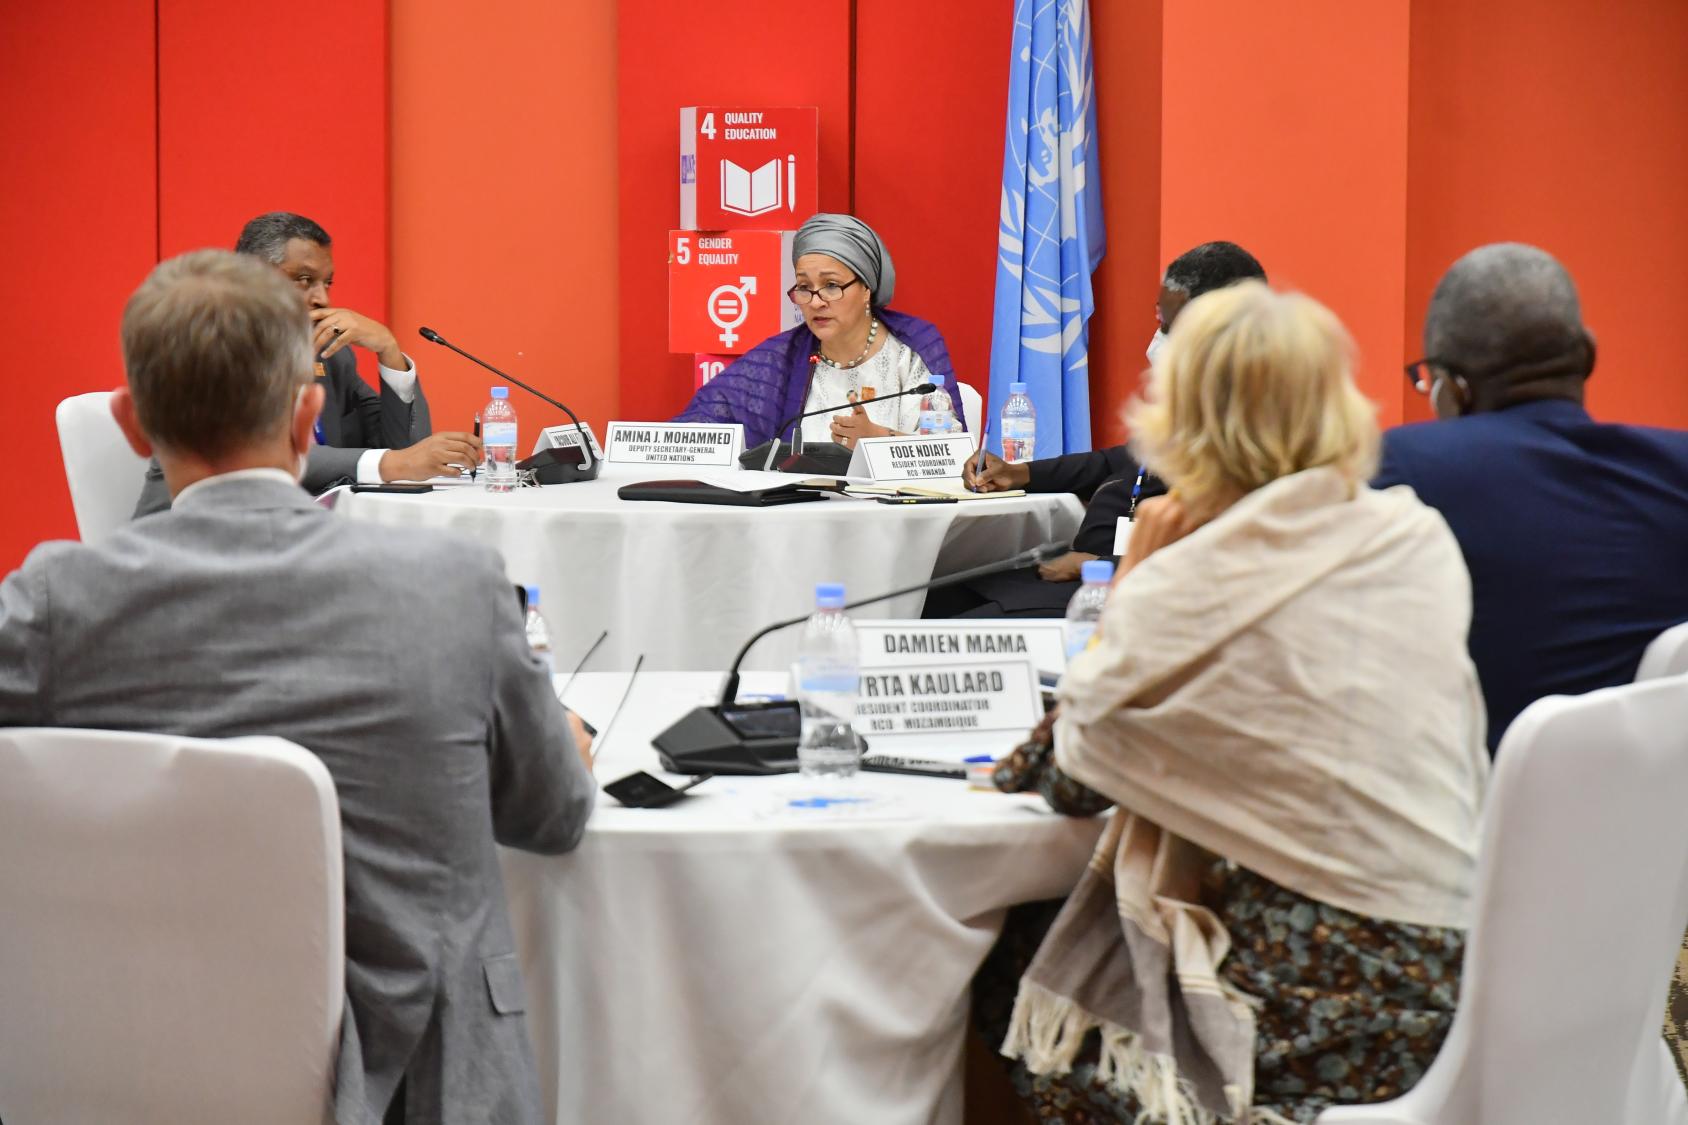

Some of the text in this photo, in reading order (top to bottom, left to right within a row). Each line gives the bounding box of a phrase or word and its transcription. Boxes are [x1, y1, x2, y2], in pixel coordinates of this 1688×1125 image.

[700, 112, 717, 140] 4
[724, 112, 763, 126] QUALITY
[724, 128, 777, 140] EDUCATION
[698, 237, 732, 249] GENDER
[676, 237, 691, 265] 5
[698, 253, 739, 266] EQUALITY
[614, 430, 731, 445] AMINA J. MOHAMMED
[653, 445, 715, 454] SECRETARY-GENERAL
[890, 444, 951, 458] FODE NDIAYE
[892, 459, 956, 469] RESIDENT COORDINATOR
[883, 634, 1028, 653] DAMIEN MAMA
[909, 671, 1004, 696] KAULARD
